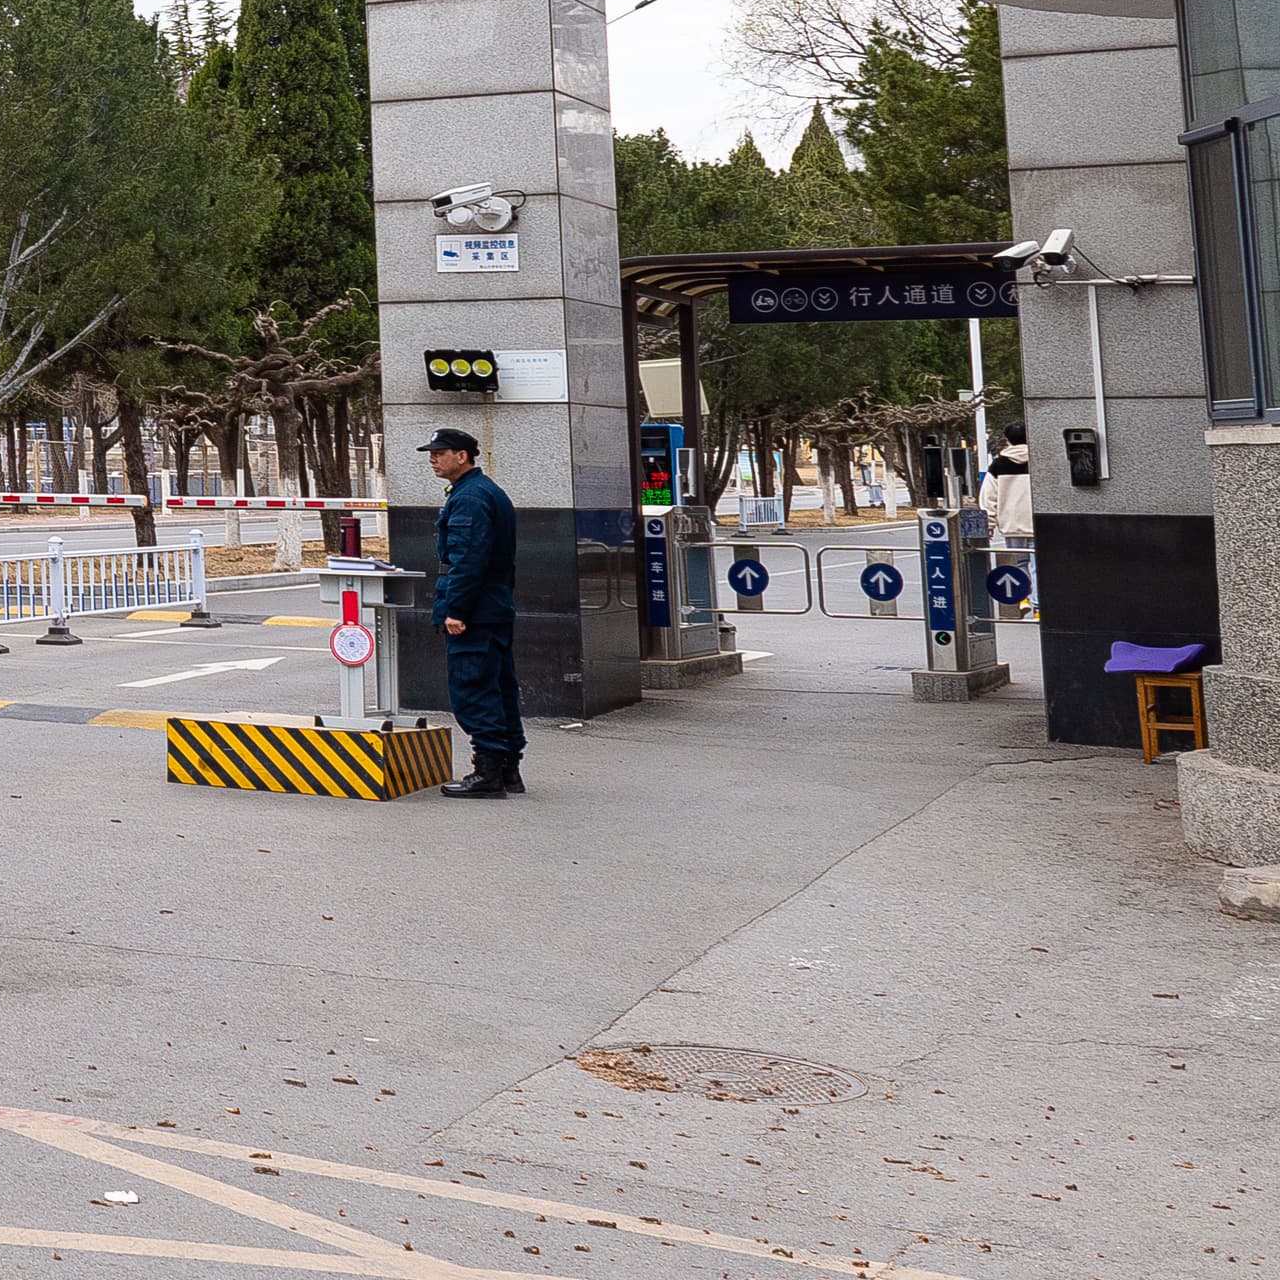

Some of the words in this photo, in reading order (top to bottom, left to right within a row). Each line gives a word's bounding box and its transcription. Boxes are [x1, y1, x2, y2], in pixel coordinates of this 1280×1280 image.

[464, 239, 516, 251] 视频监控信息
[849, 283, 956, 307] 行人通道
[649, 551, 666, 602] 一车一进
[928, 555, 948, 610] 一人一进
